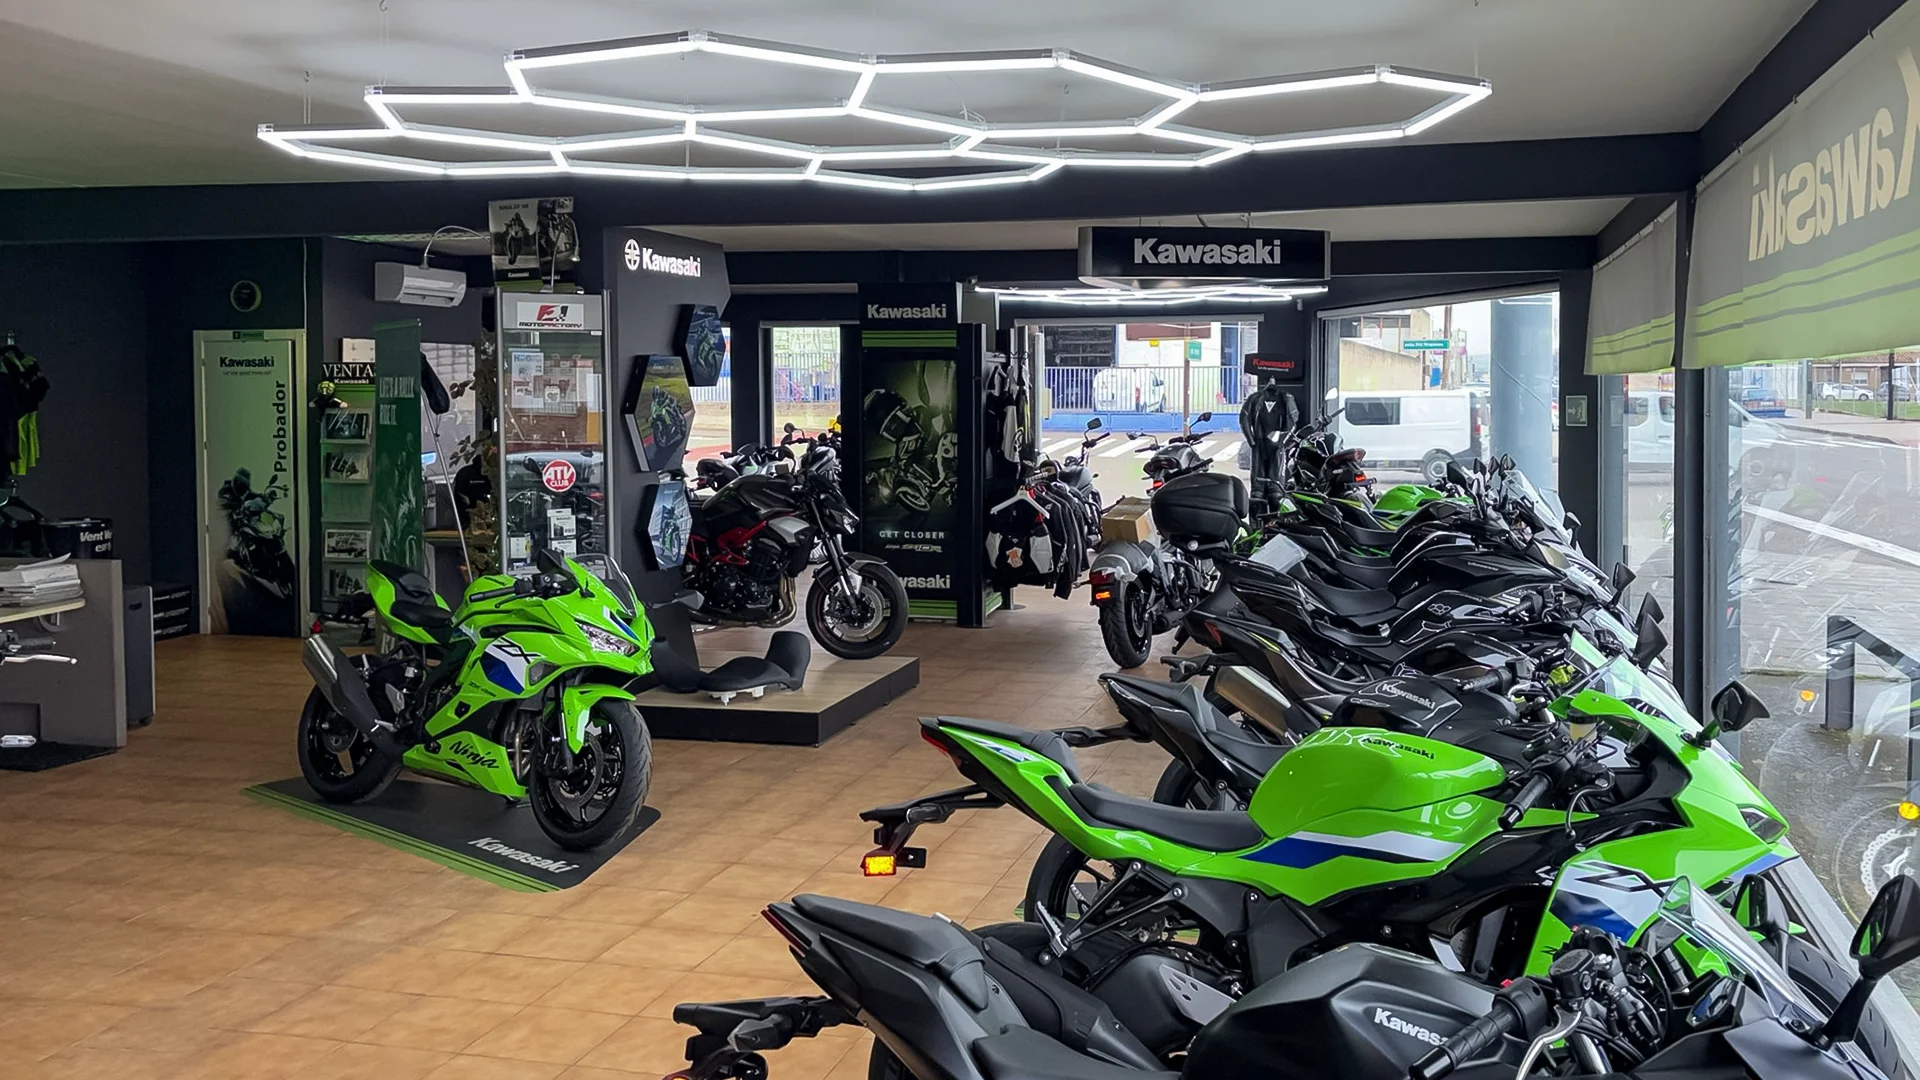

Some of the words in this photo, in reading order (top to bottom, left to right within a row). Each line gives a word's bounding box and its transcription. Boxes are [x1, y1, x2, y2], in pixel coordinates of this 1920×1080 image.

[1134, 238, 1281, 264] Kawasaki
[642, 247, 701, 278] Kawasaki
[867, 303, 947, 318] Kawasaki
[220, 356, 275, 367] Kawasaki
[1253, 358, 1295, 369] Kawasaki
[323, 364, 376, 378] VENTA
[272, 380, 287, 472] Probador
[544, 466, 573, 480] ATV
[80, 530, 103, 542] Vent
[879, 530, 899, 538] GET
[904, 531, 945, 539] CLOSER
[898, 574, 951, 589] wasaki
[1382, 683, 1436, 709] Kawasaki
[450, 741, 499, 768] Ninja
[1362, 737, 1435, 759] Kawasaki
[468, 837, 580, 873] Kawasaki
[1374, 1008, 1449, 1046] Kawas
